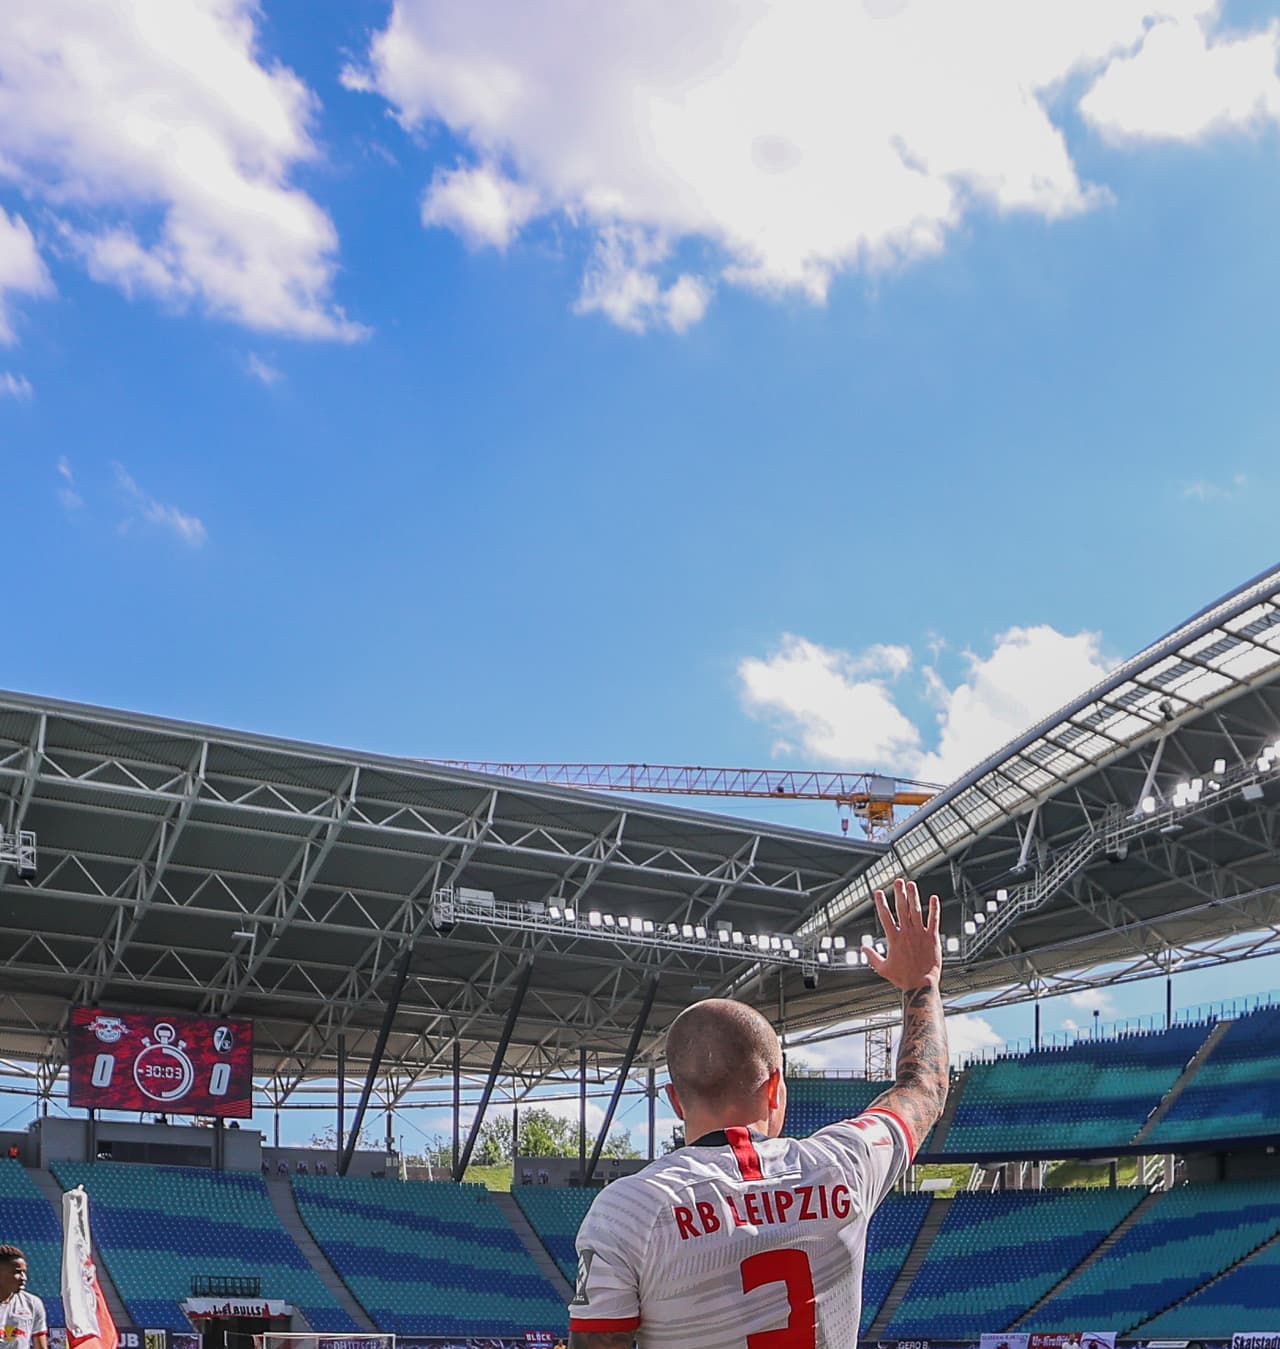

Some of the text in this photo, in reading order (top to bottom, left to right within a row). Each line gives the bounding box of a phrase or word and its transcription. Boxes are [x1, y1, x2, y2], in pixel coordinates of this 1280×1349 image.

[91, 1053, 115, 1088] 0
[209, 1062, 232, 1096] 0
[674, 1184, 851, 1240] RB LEIPZIG
[233, 1305, 262, 1316] BULLS
[525, 1332, 552, 1342] BLOCK
